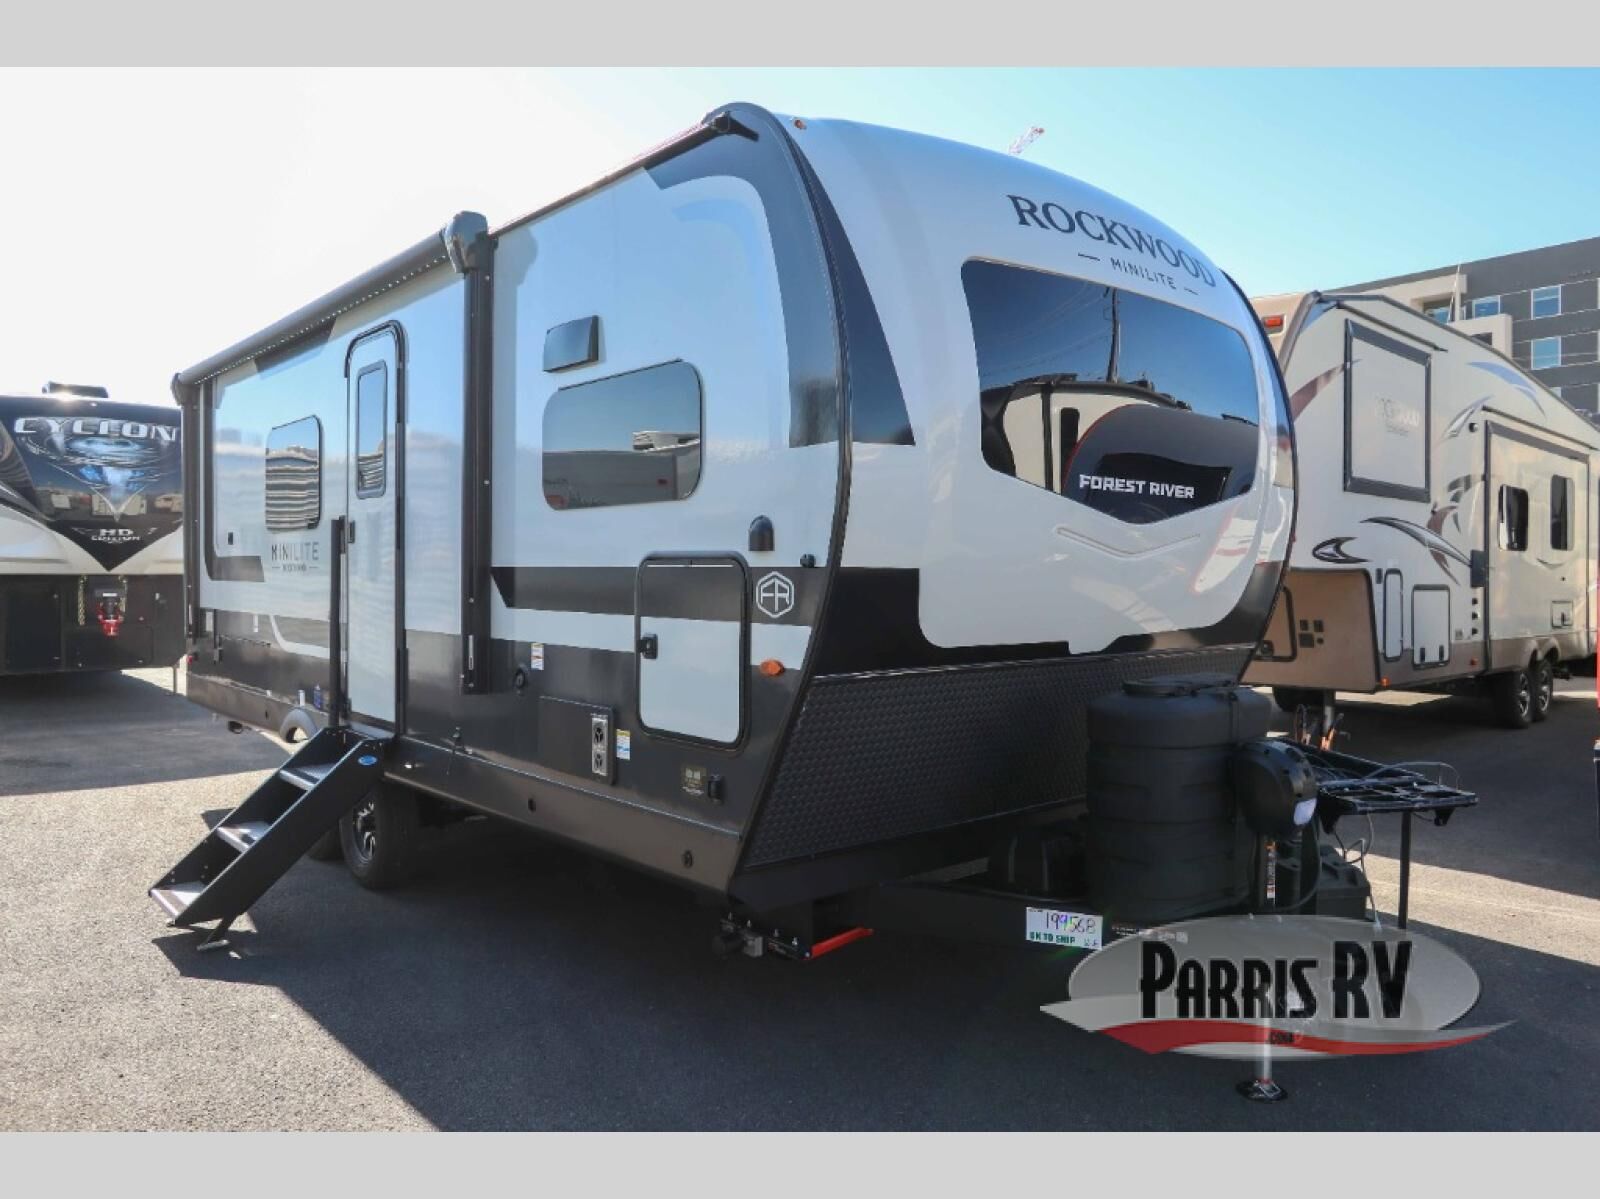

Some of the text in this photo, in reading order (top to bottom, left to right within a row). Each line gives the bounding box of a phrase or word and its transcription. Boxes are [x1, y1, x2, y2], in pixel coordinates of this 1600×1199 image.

[1007, 194, 1216, 288] ROCKWOOD
[1110, 256, 1177, 290] MINILITE
[1079, 474, 1195, 499] FOREST RIVER
[1055, 934, 1076, 944] SHIP
